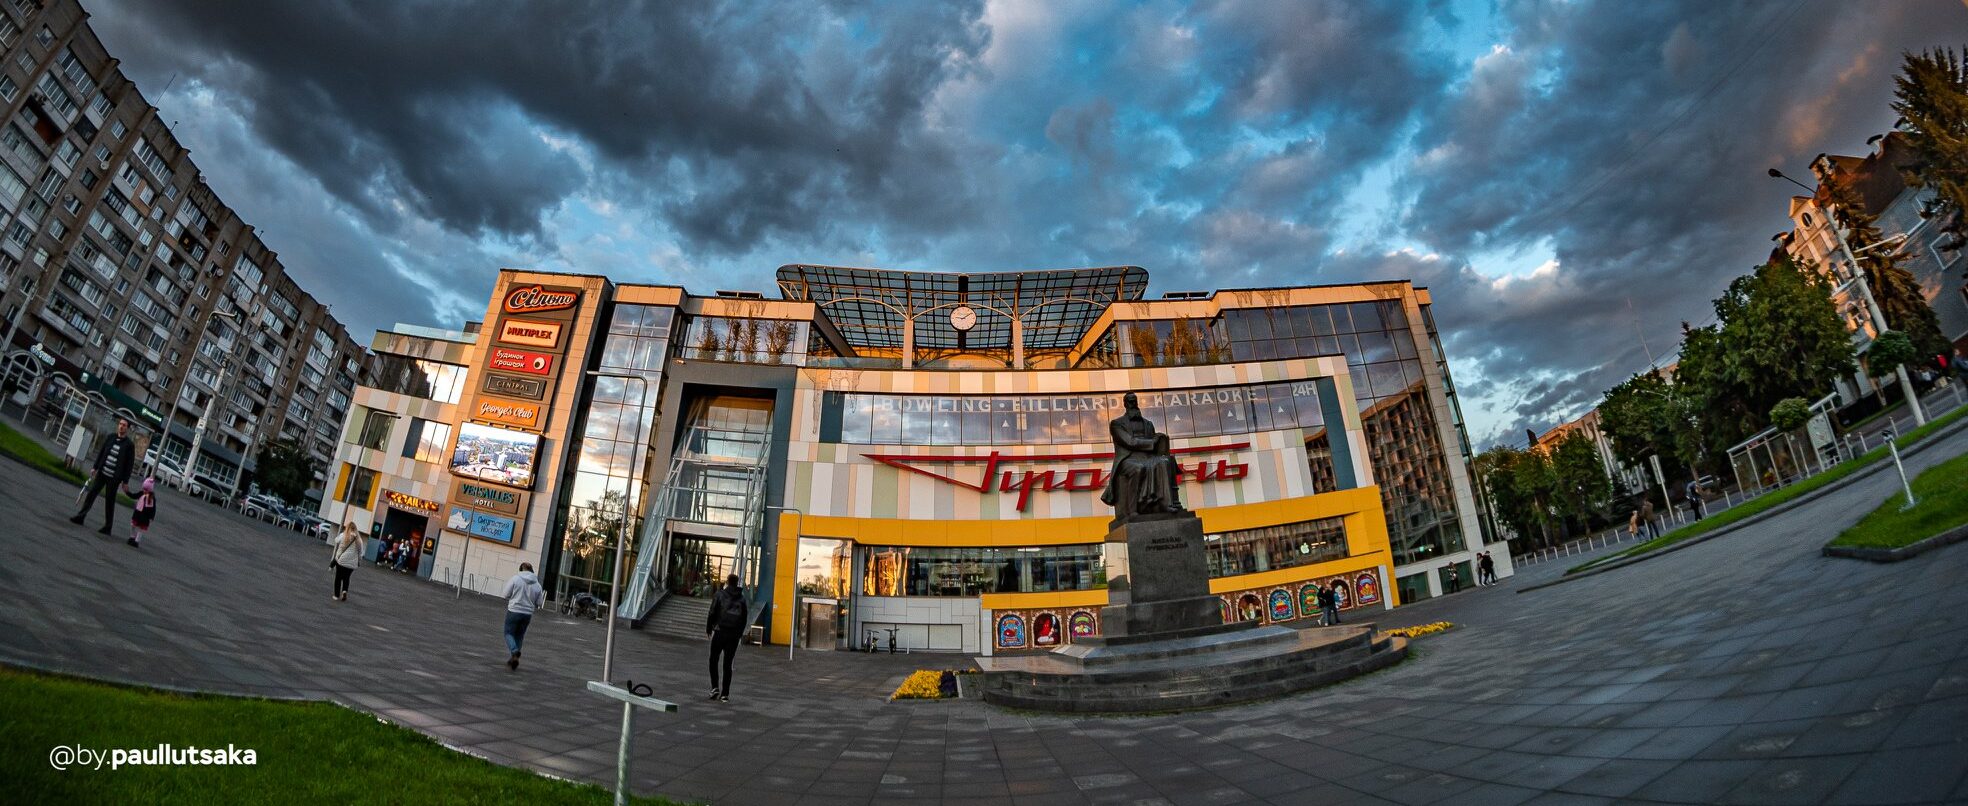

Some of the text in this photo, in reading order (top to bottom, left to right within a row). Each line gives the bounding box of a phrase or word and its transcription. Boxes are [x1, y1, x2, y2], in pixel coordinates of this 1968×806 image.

[508, 288, 575, 309] Сільпо
[507, 326, 553, 340] MULTIPLEX
[496, 350, 524, 360] будинок
[496, 380, 529, 391] CENTRAL
[881, 398, 992, 413] BOWLING
[1153, 387, 1257, 408] KARAOKE
[1292, 382, 1317, 397] 24H
[480, 402, 533, 419] George's Club
[461, 483, 514, 504] VERSAILLES
[474, 499, 494, 508] HOTEL
